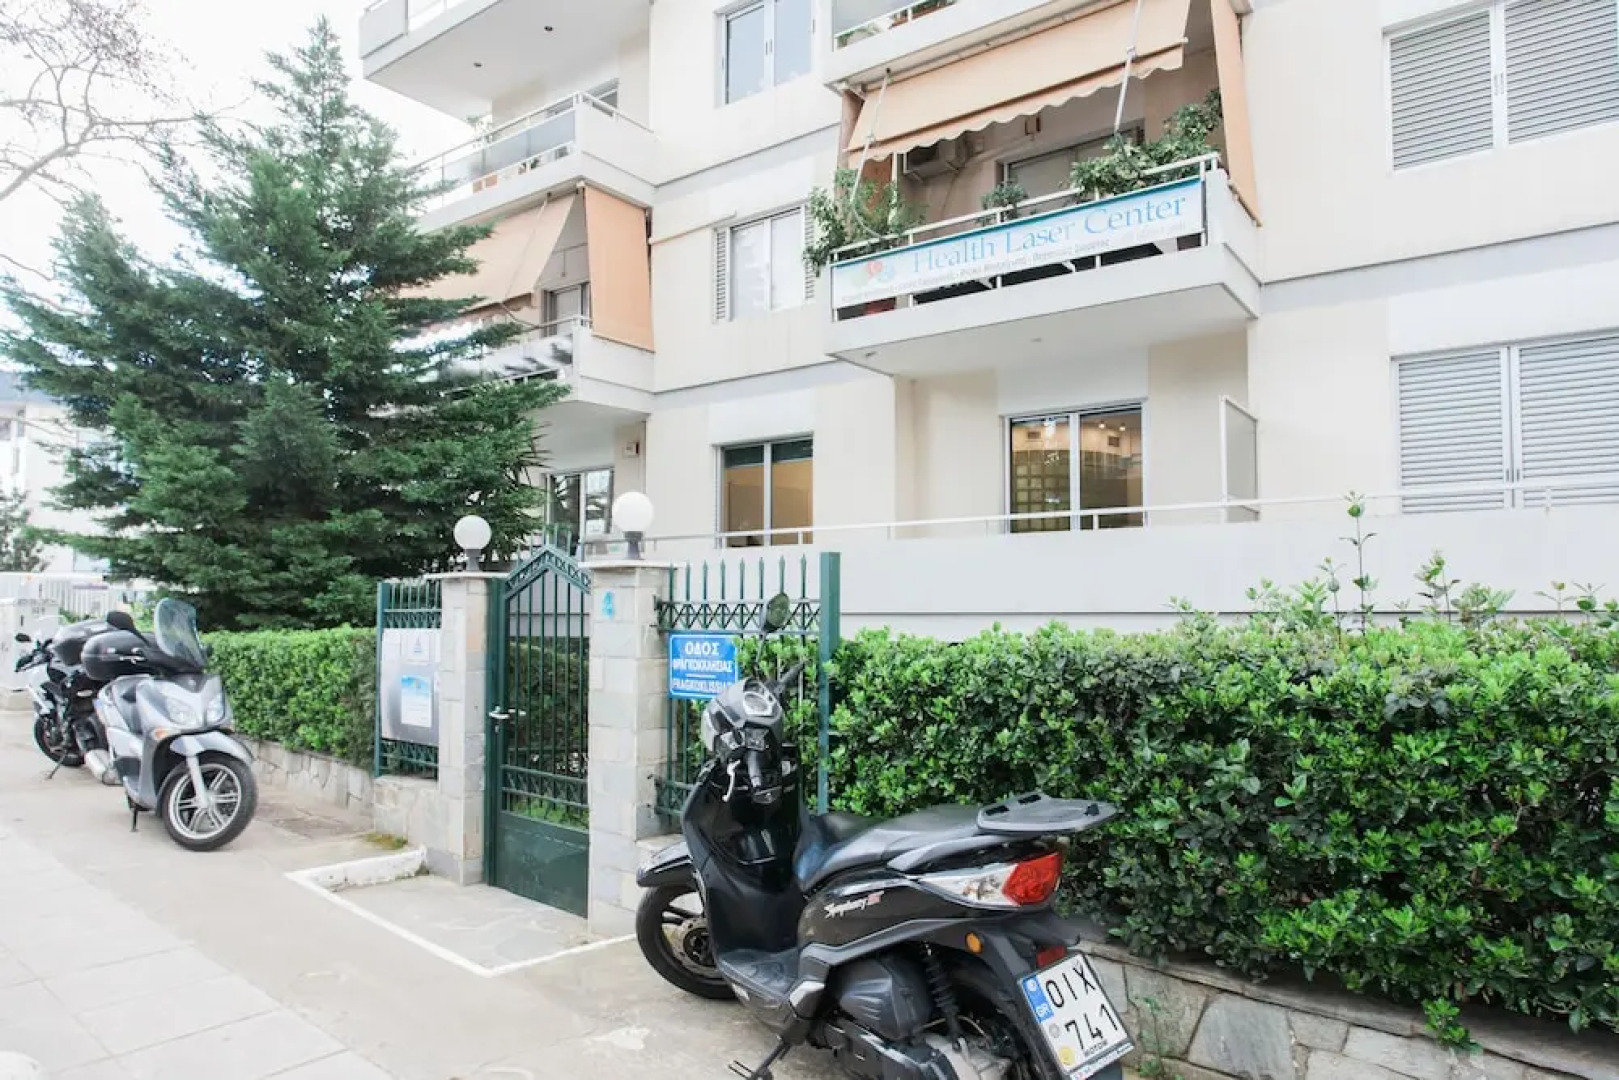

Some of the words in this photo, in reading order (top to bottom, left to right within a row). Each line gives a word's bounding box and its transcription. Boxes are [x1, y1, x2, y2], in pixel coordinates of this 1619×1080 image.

[913, 236, 995, 273] Health
[1006, 222, 1076, 254] Laser
[1084, 196, 1186, 235] Center
[684, 641, 720, 655] ΟΔΟΣ
[1045, 961, 1096, 1008] OIX
[1064, 1003, 1118, 1050] 741
